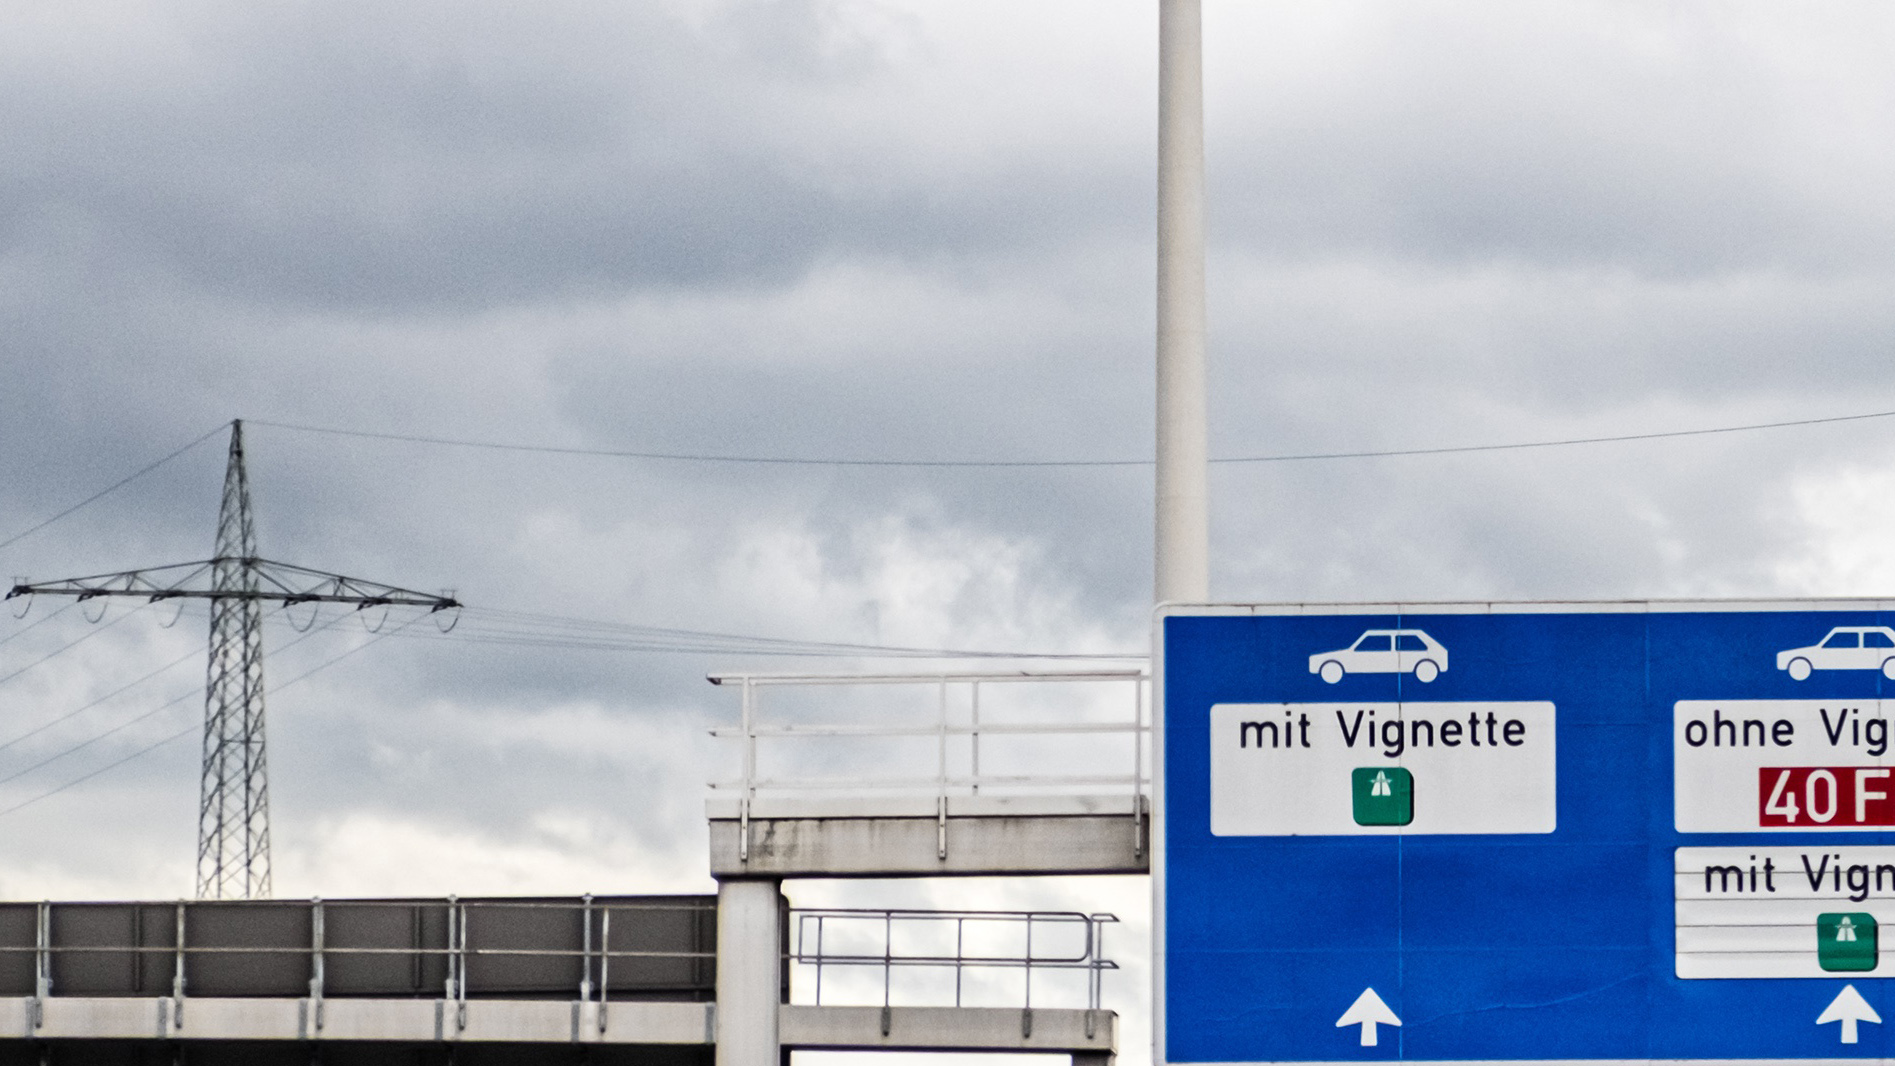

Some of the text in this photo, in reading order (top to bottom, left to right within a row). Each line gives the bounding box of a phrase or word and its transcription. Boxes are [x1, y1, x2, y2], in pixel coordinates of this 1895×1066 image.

[1240, 709, 1526, 758] mit Vignette
[1684, 709, 1795, 747] ohne
[1764, 768, 1838, 823] 40
[1704, 854, 1776, 892] mit
